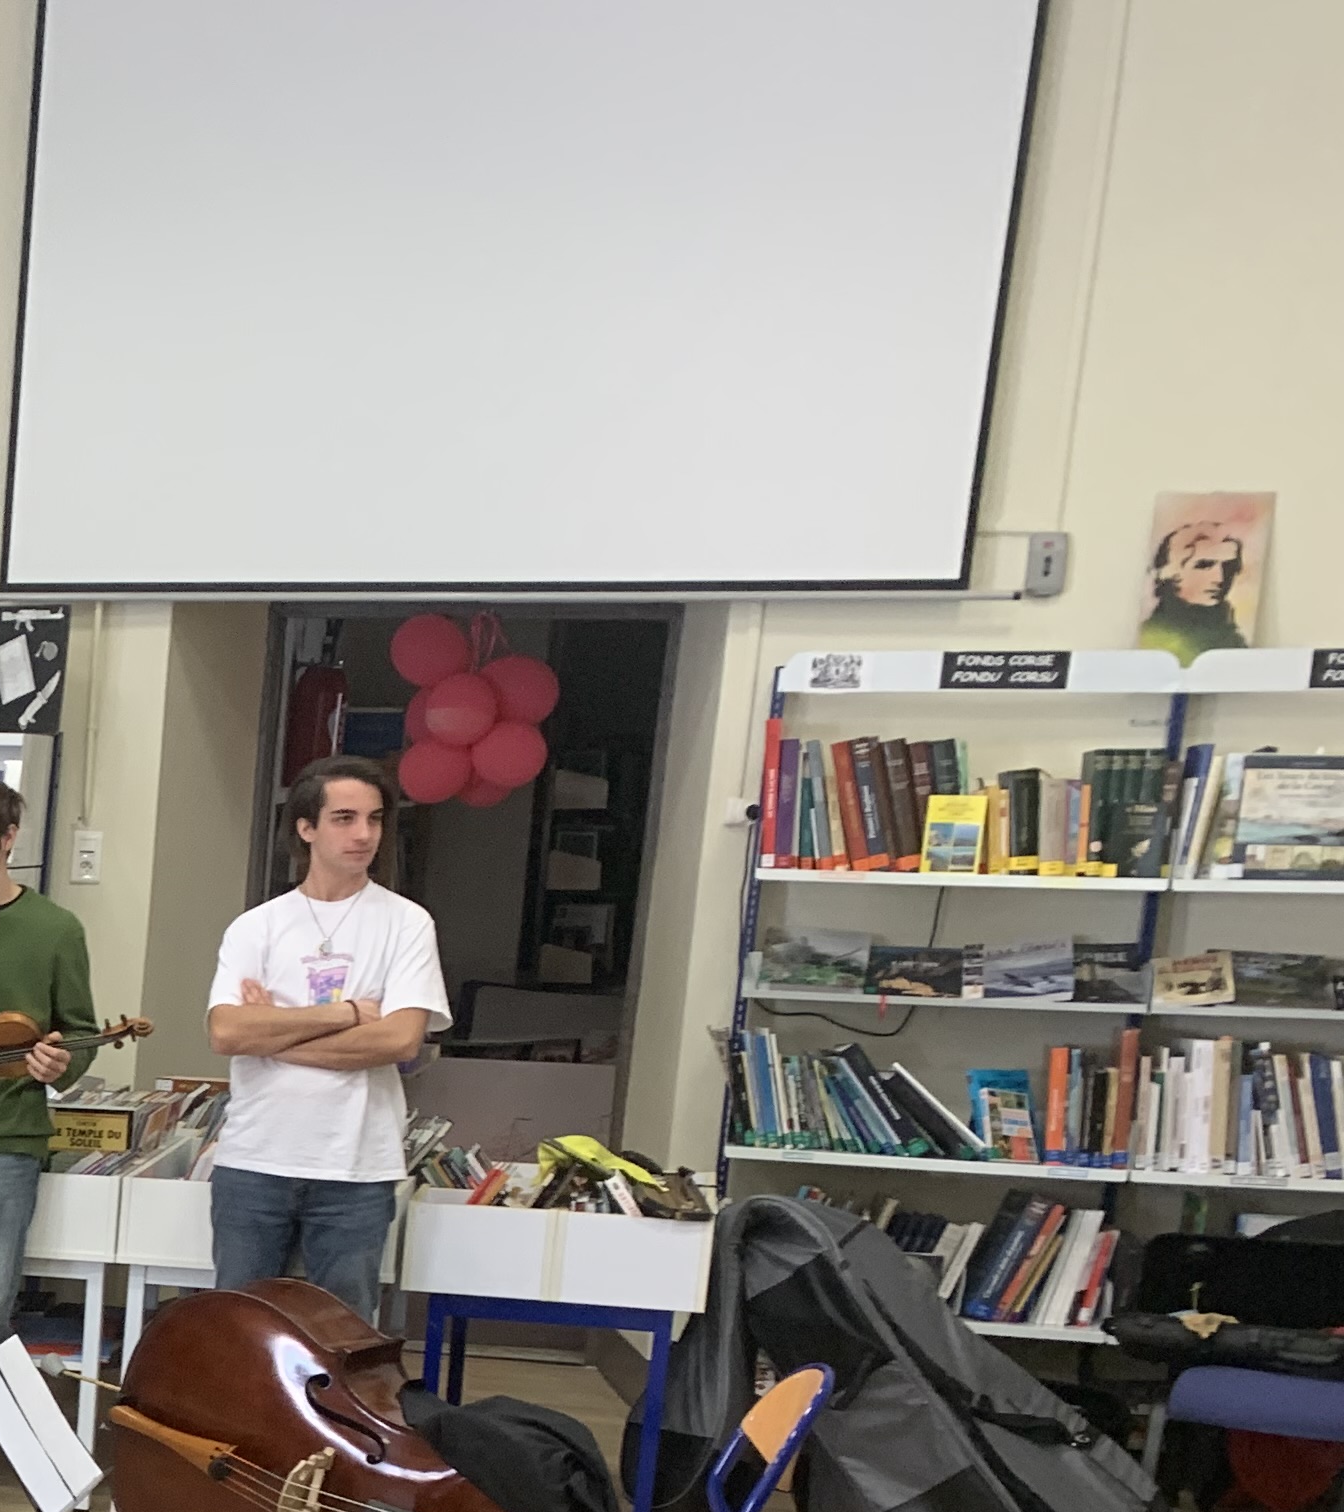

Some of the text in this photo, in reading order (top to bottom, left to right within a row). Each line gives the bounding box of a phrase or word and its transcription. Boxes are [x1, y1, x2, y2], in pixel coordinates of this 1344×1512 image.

[956, 654, 1056, 667] FONDS CORSE
[951, 671, 1058, 682] FONDU CORSU
[66, 1127, 104, 1139] TEMPLE
[107, 1130, 122, 1140] DU
[69, 1137, 102, 1148] SOLEIL
